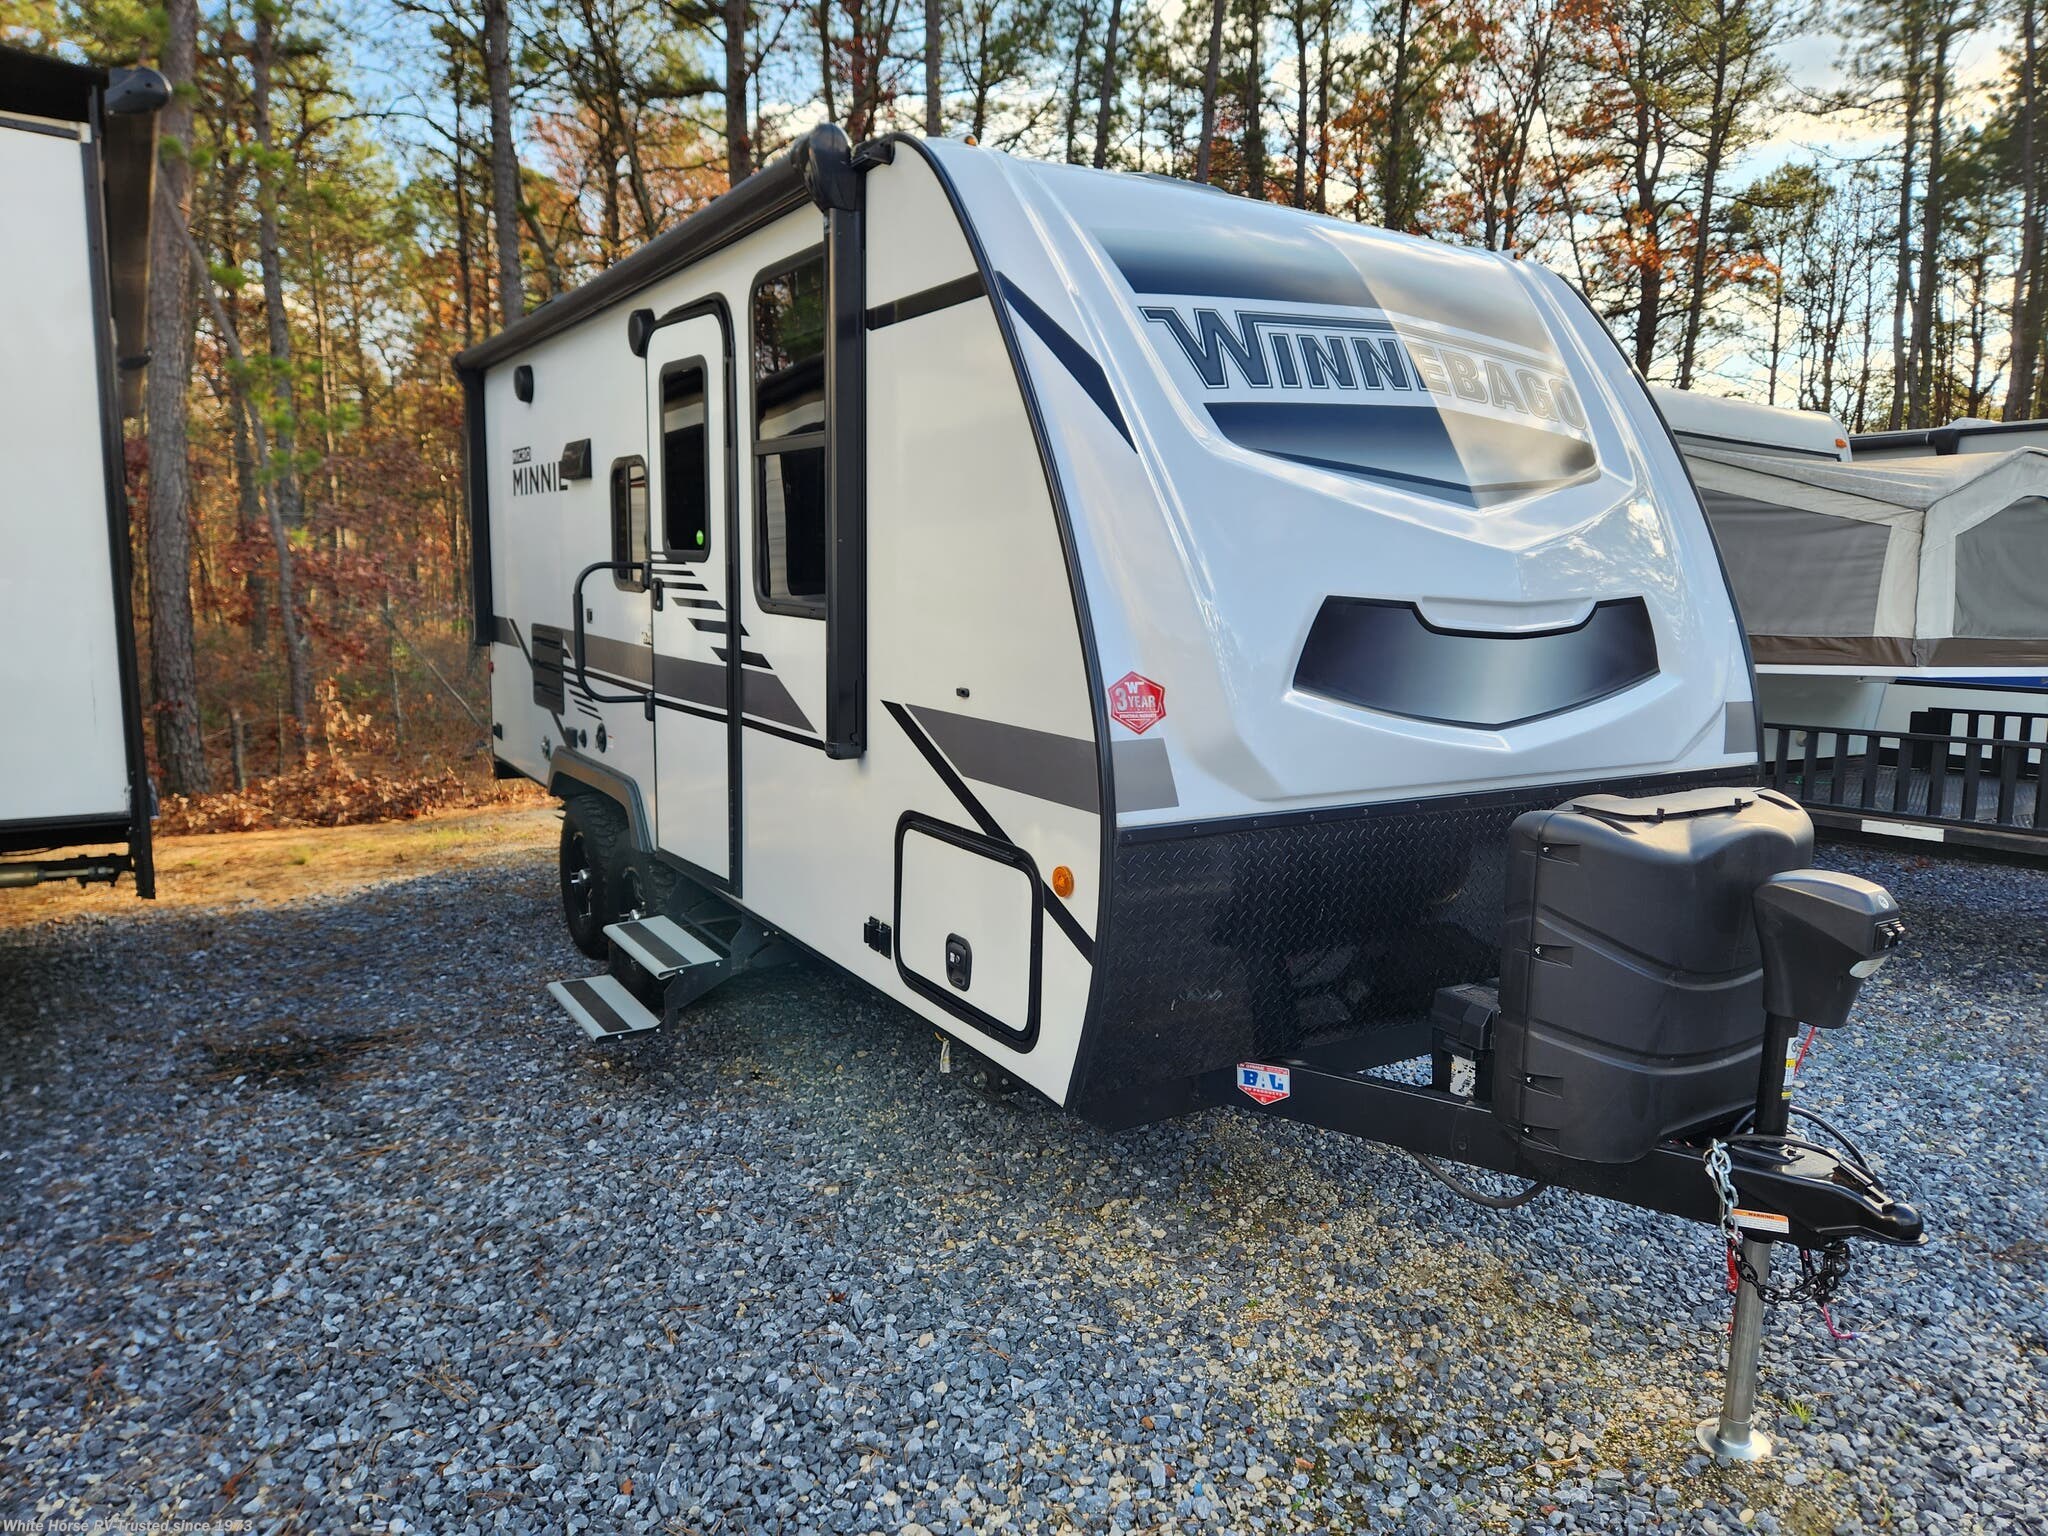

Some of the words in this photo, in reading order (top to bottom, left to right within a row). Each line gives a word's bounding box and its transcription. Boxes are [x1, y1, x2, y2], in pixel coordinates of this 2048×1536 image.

[1138, 306, 1587, 431] WINNEBAGO
[1115, 687, 1127, 711] 3
[1127, 695, 1156, 708] YEAR
